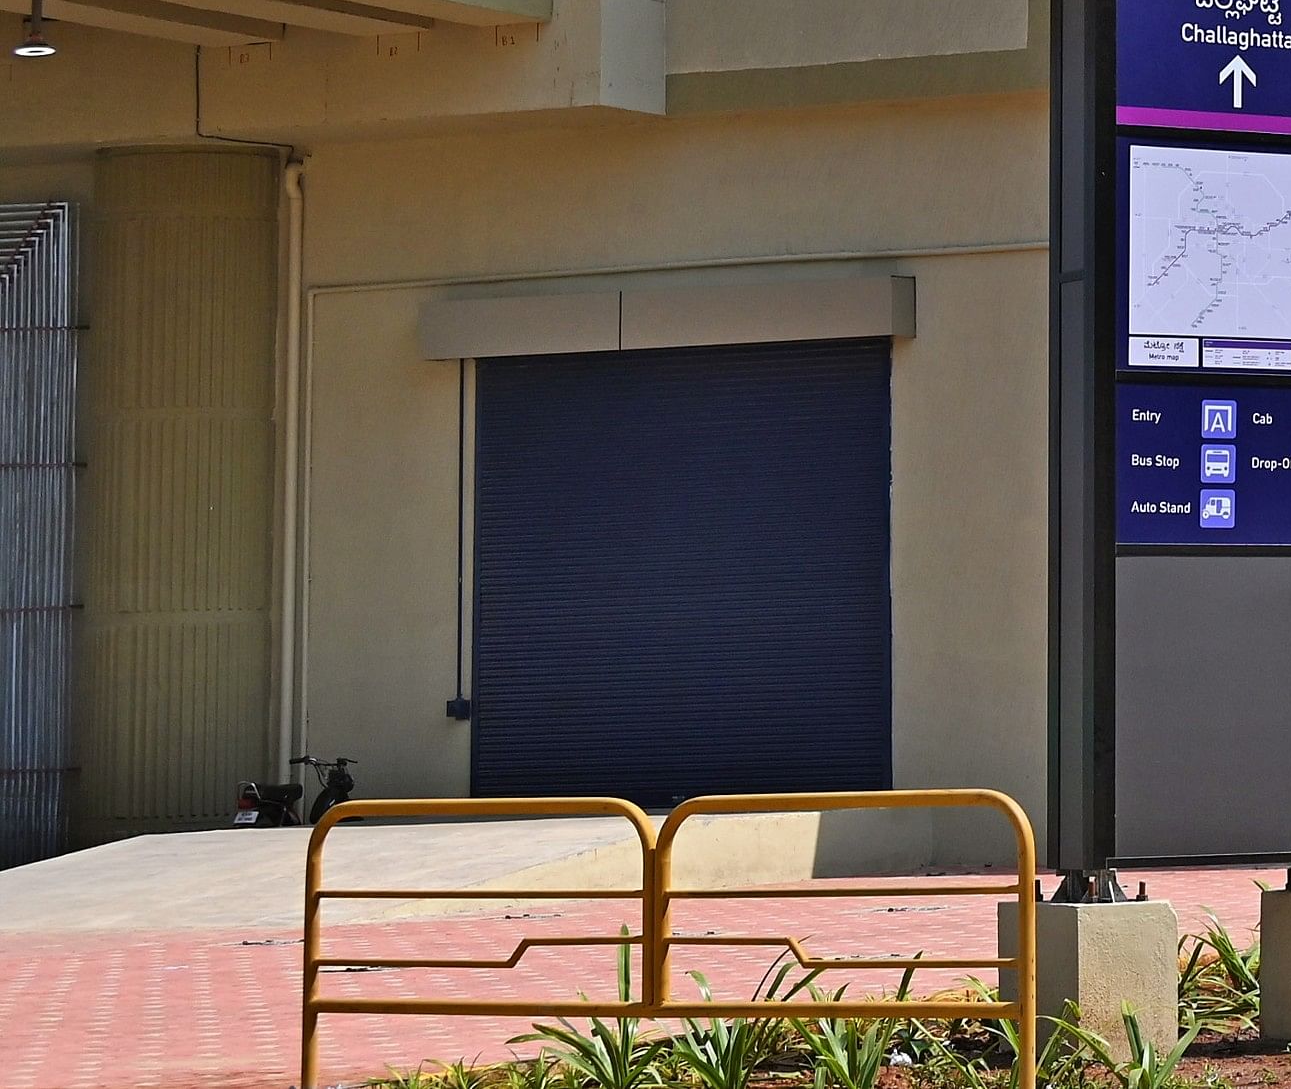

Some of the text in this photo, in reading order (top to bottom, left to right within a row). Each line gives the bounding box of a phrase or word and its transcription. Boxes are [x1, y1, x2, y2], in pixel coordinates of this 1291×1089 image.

[1132, 409, 1162, 424] Entry
[1252, 412, 1273, 425] Cab
[1131, 454, 1180, 470] Bus Stop
[1131, 501, 1191, 514] Auto Stand
